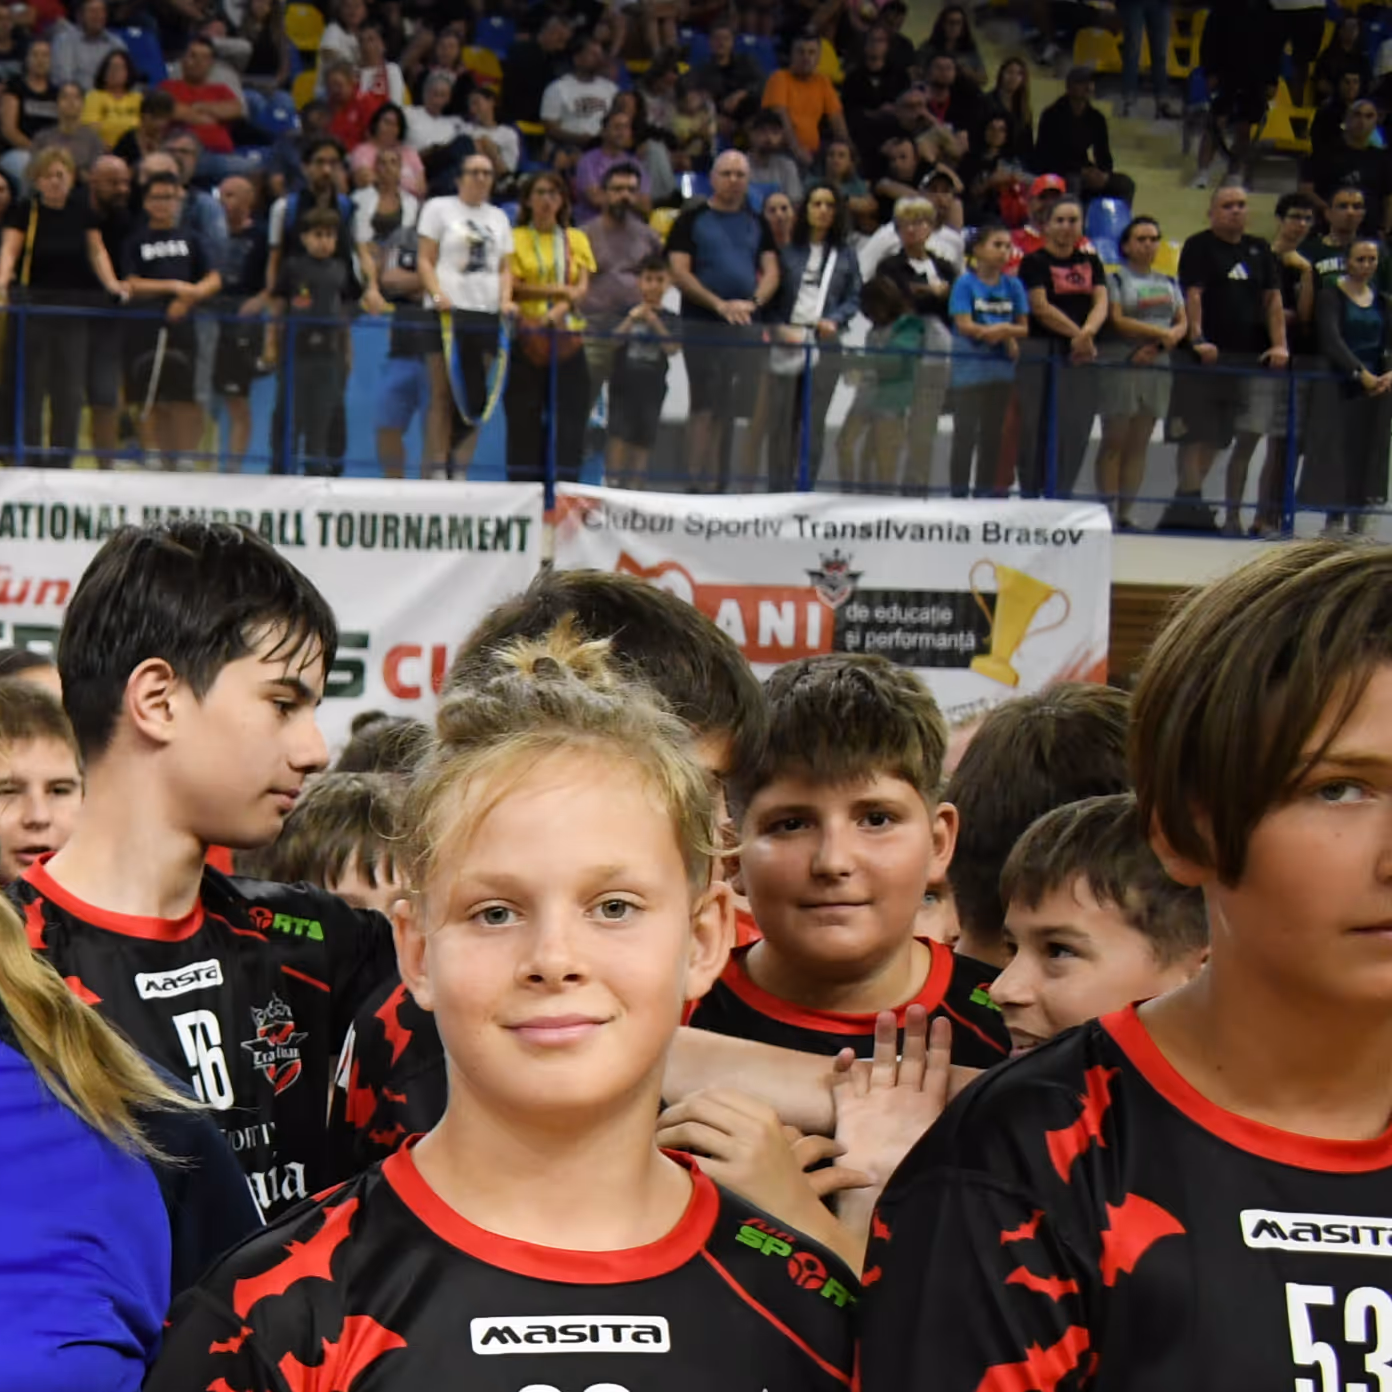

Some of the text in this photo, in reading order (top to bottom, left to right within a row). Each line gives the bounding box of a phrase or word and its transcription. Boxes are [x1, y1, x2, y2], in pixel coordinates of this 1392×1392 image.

[317, 511, 532, 552] TOURNAMENT
[582, 506, 674, 535] Clubul
[684, 512, 783, 541] Sportiv
[792, 514, 971, 543] Transilvania
[845, 602, 869, 623] de
